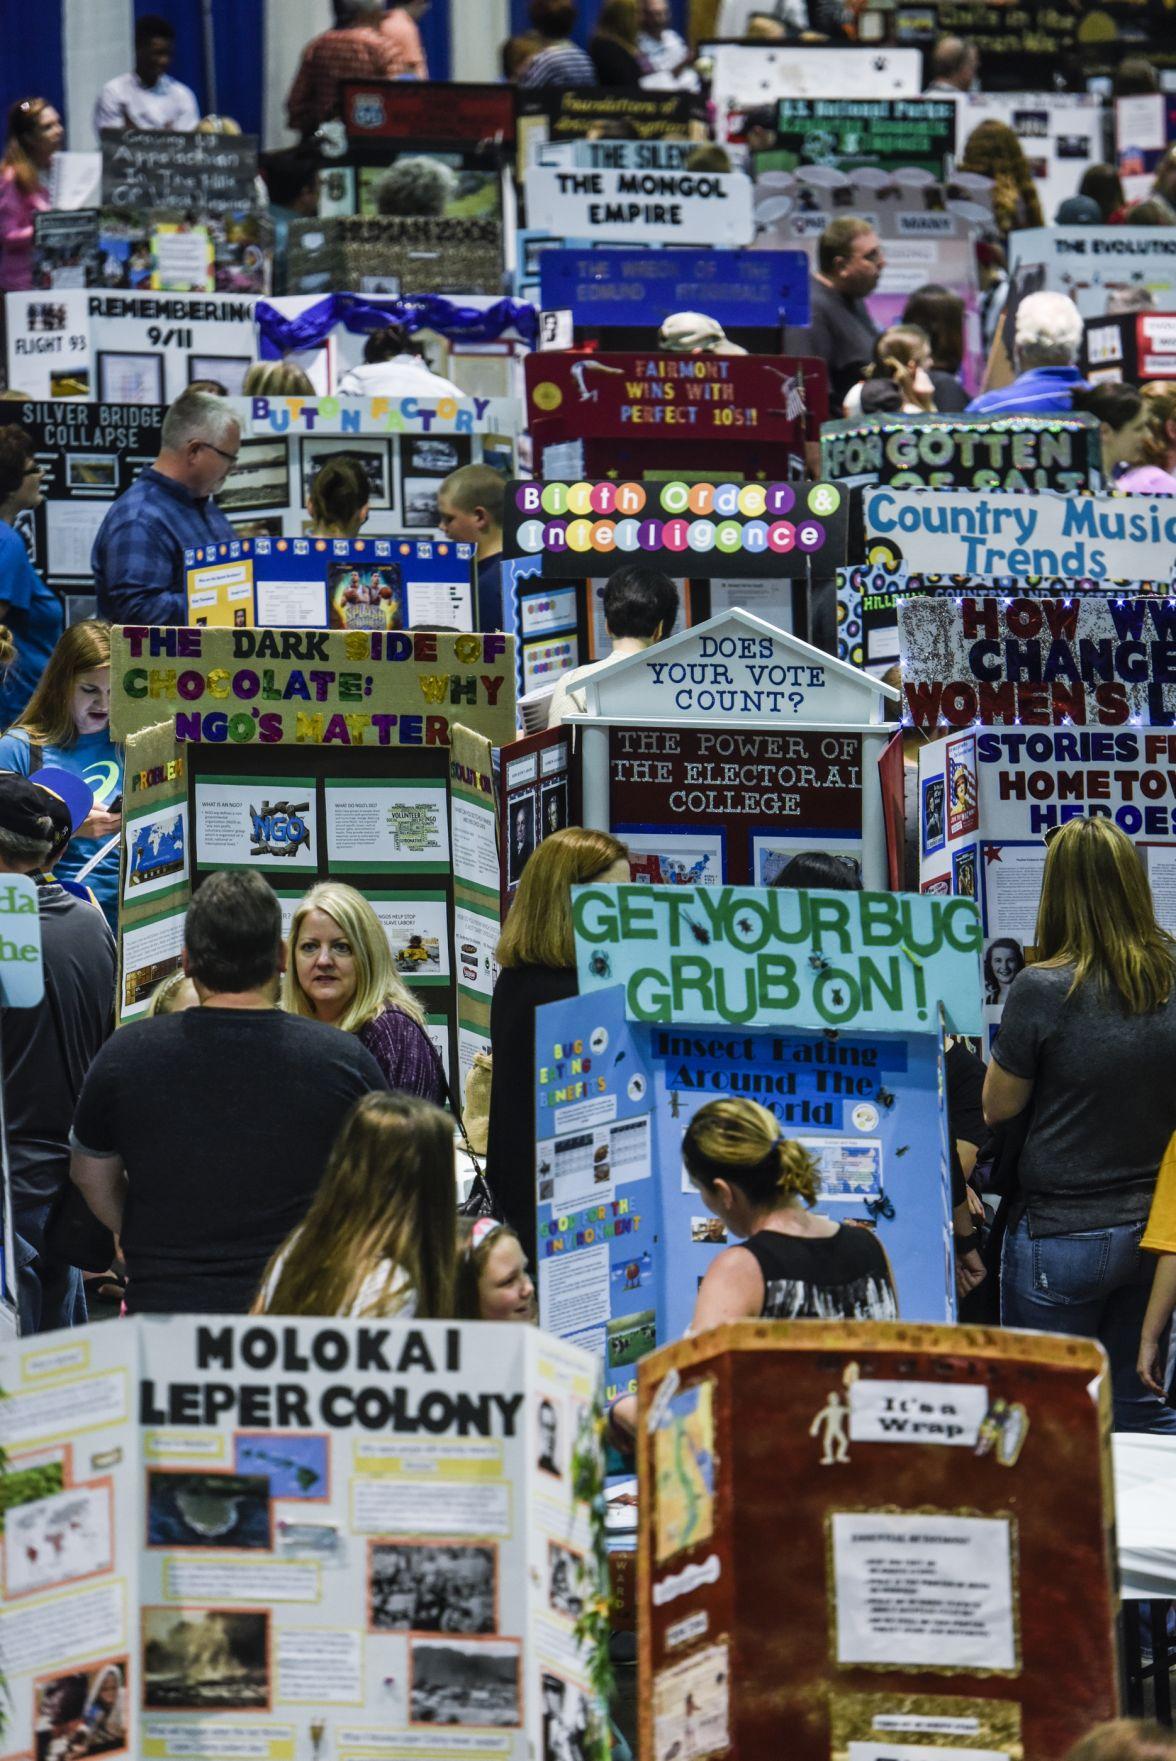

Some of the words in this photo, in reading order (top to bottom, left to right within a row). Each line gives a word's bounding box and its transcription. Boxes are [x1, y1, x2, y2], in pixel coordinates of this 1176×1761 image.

[590, 143, 626, 169] THE
[556, 173, 605, 194] THE
[618, 174, 728, 199] MONGOL
[588, 203, 682, 225] EMPIRE
[1055, 239, 1085, 254] THE
[15, 335, 62, 354] FLIGHT
[69, 335, 87, 350] 93
[147, 326, 192, 348] 9/11
[635, 361, 729, 379] FAIRMONT
[626, 382, 675, 400] WINS
[686, 383, 734, 400] WITH
[23, 403, 88, 425] SILVER
[100, 406, 162, 428] BRIDGE
[252, 396, 361, 432] BUTTON
[371, 396, 490, 433] FACTORY
[620, 406, 698, 423] PERFECT
[44, 425, 139, 448] COLLAPSE
[525, 487, 639, 510] Birth
[667, 487, 784, 510] Order
[814, 491, 832, 509] &
[868, 493, 1037, 545] Country
[1062, 498, 1176, 543] Music
[528, 522, 819, 547] Intelligence
[961, 535, 1107, 579] Trends
[963, 598, 1080, 640] HOW
[123, 627, 203, 658] THE
[233, 629, 329, 662] DARK
[345, 631, 438, 662] SIDE
[454, 633, 505, 664] OF
[699, 637, 774, 660] DOES
[968, 638, 1176, 683] CHANGE
[123, 668, 373, 701] CHOCOLATE:
[419, 674, 504, 706] WHY
[647, 663, 733, 685] YOUR
[746, 665, 825, 688] VOTE
[675, 689, 804, 713] COUNT?
[176, 706, 283, 744] NGO'S
[296, 711, 451, 746] MATTER
[618, 731, 681, 754] THE
[697, 733, 809, 760] POWER
[821, 738, 858, 760] OF
[977, 732, 1139, 764] STORIES
[132, 758, 183, 793] PROBLEM
[611, 760, 673, 783] THE
[669, 790, 801, 816] COLLEGE
[252, 815, 304, 842] NGO
[571, 885, 695, 946] GET
[695, 887, 853, 954] YOUR
[858, 890, 982, 957] BUG
[627, 953, 799, 1024] GRUB
[813, 955, 928, 1024] ON!
[554, 1040, 583, 1060] BUG
[658, 1032, 754, 1061] Insect
[772, 1038, 878, 1068] Eating
[672, 1064, 797, 1096] Around
[815, 1070, 874, 1097] The
[735, 1094, 833, 1125] orld
[197, 1327, 460, 1372] MOLOKAI
[140, 1380, 311, 1427] LEPER
[320, 1385, 524, 1437] COLONY
[885, 1397, 935, 1413] It's
[878, 1417, 965, 1438] Wrap
